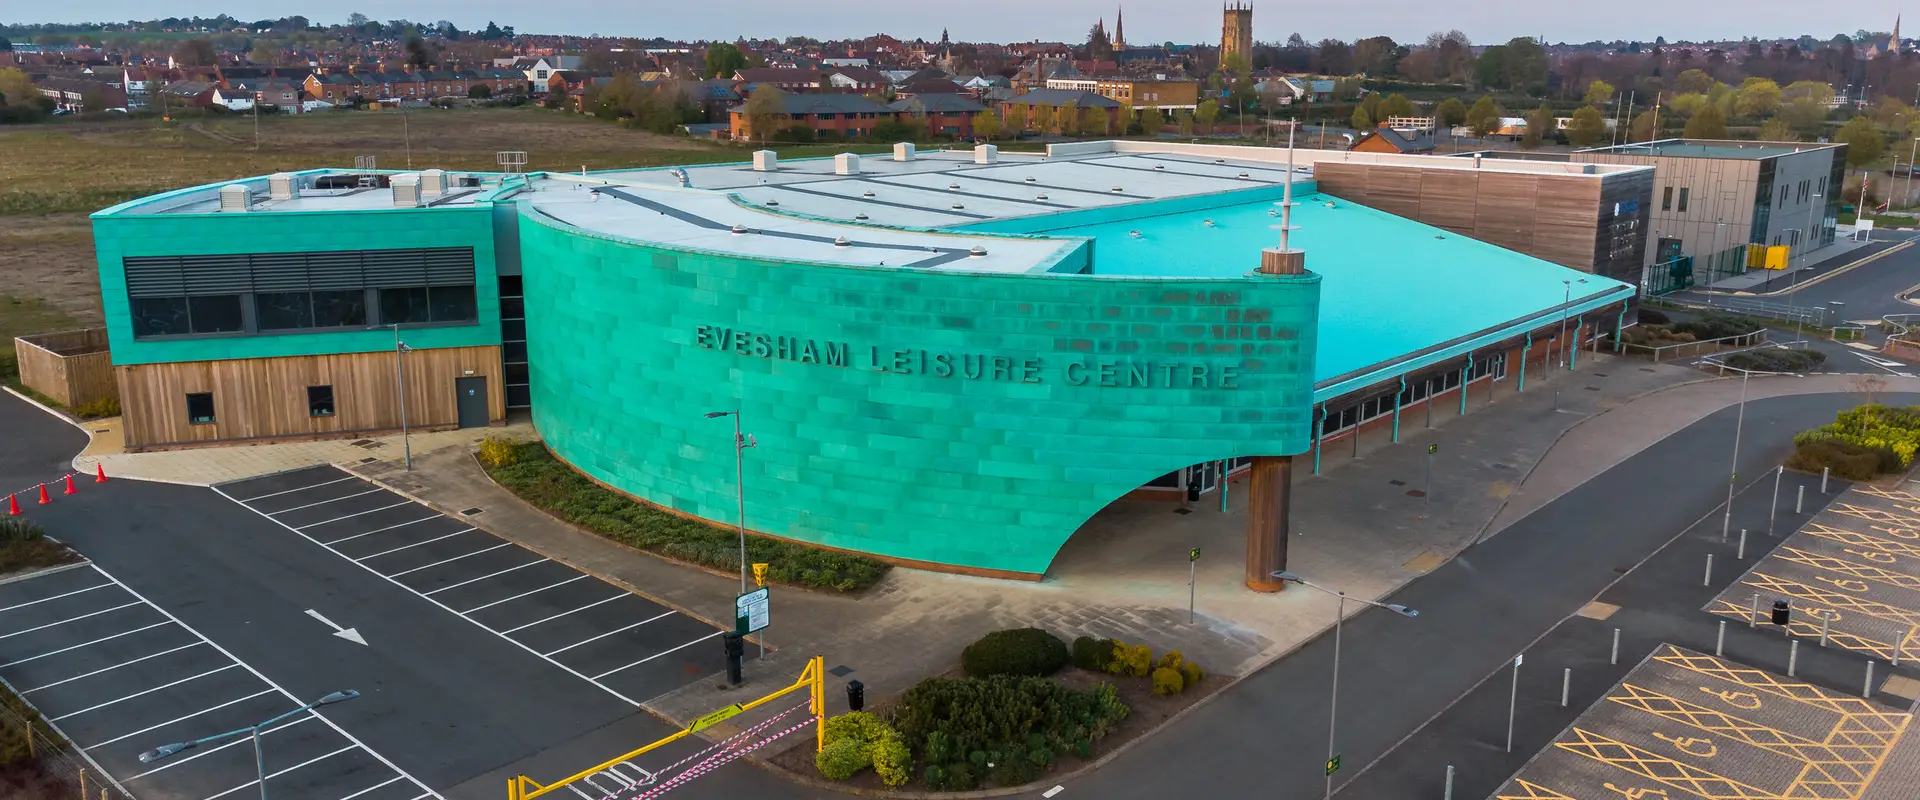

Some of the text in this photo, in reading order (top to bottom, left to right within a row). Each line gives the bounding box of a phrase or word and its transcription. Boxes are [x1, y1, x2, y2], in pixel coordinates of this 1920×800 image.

[697, 325, 1240, 389] EVESHAM LEISURE CENTRE
